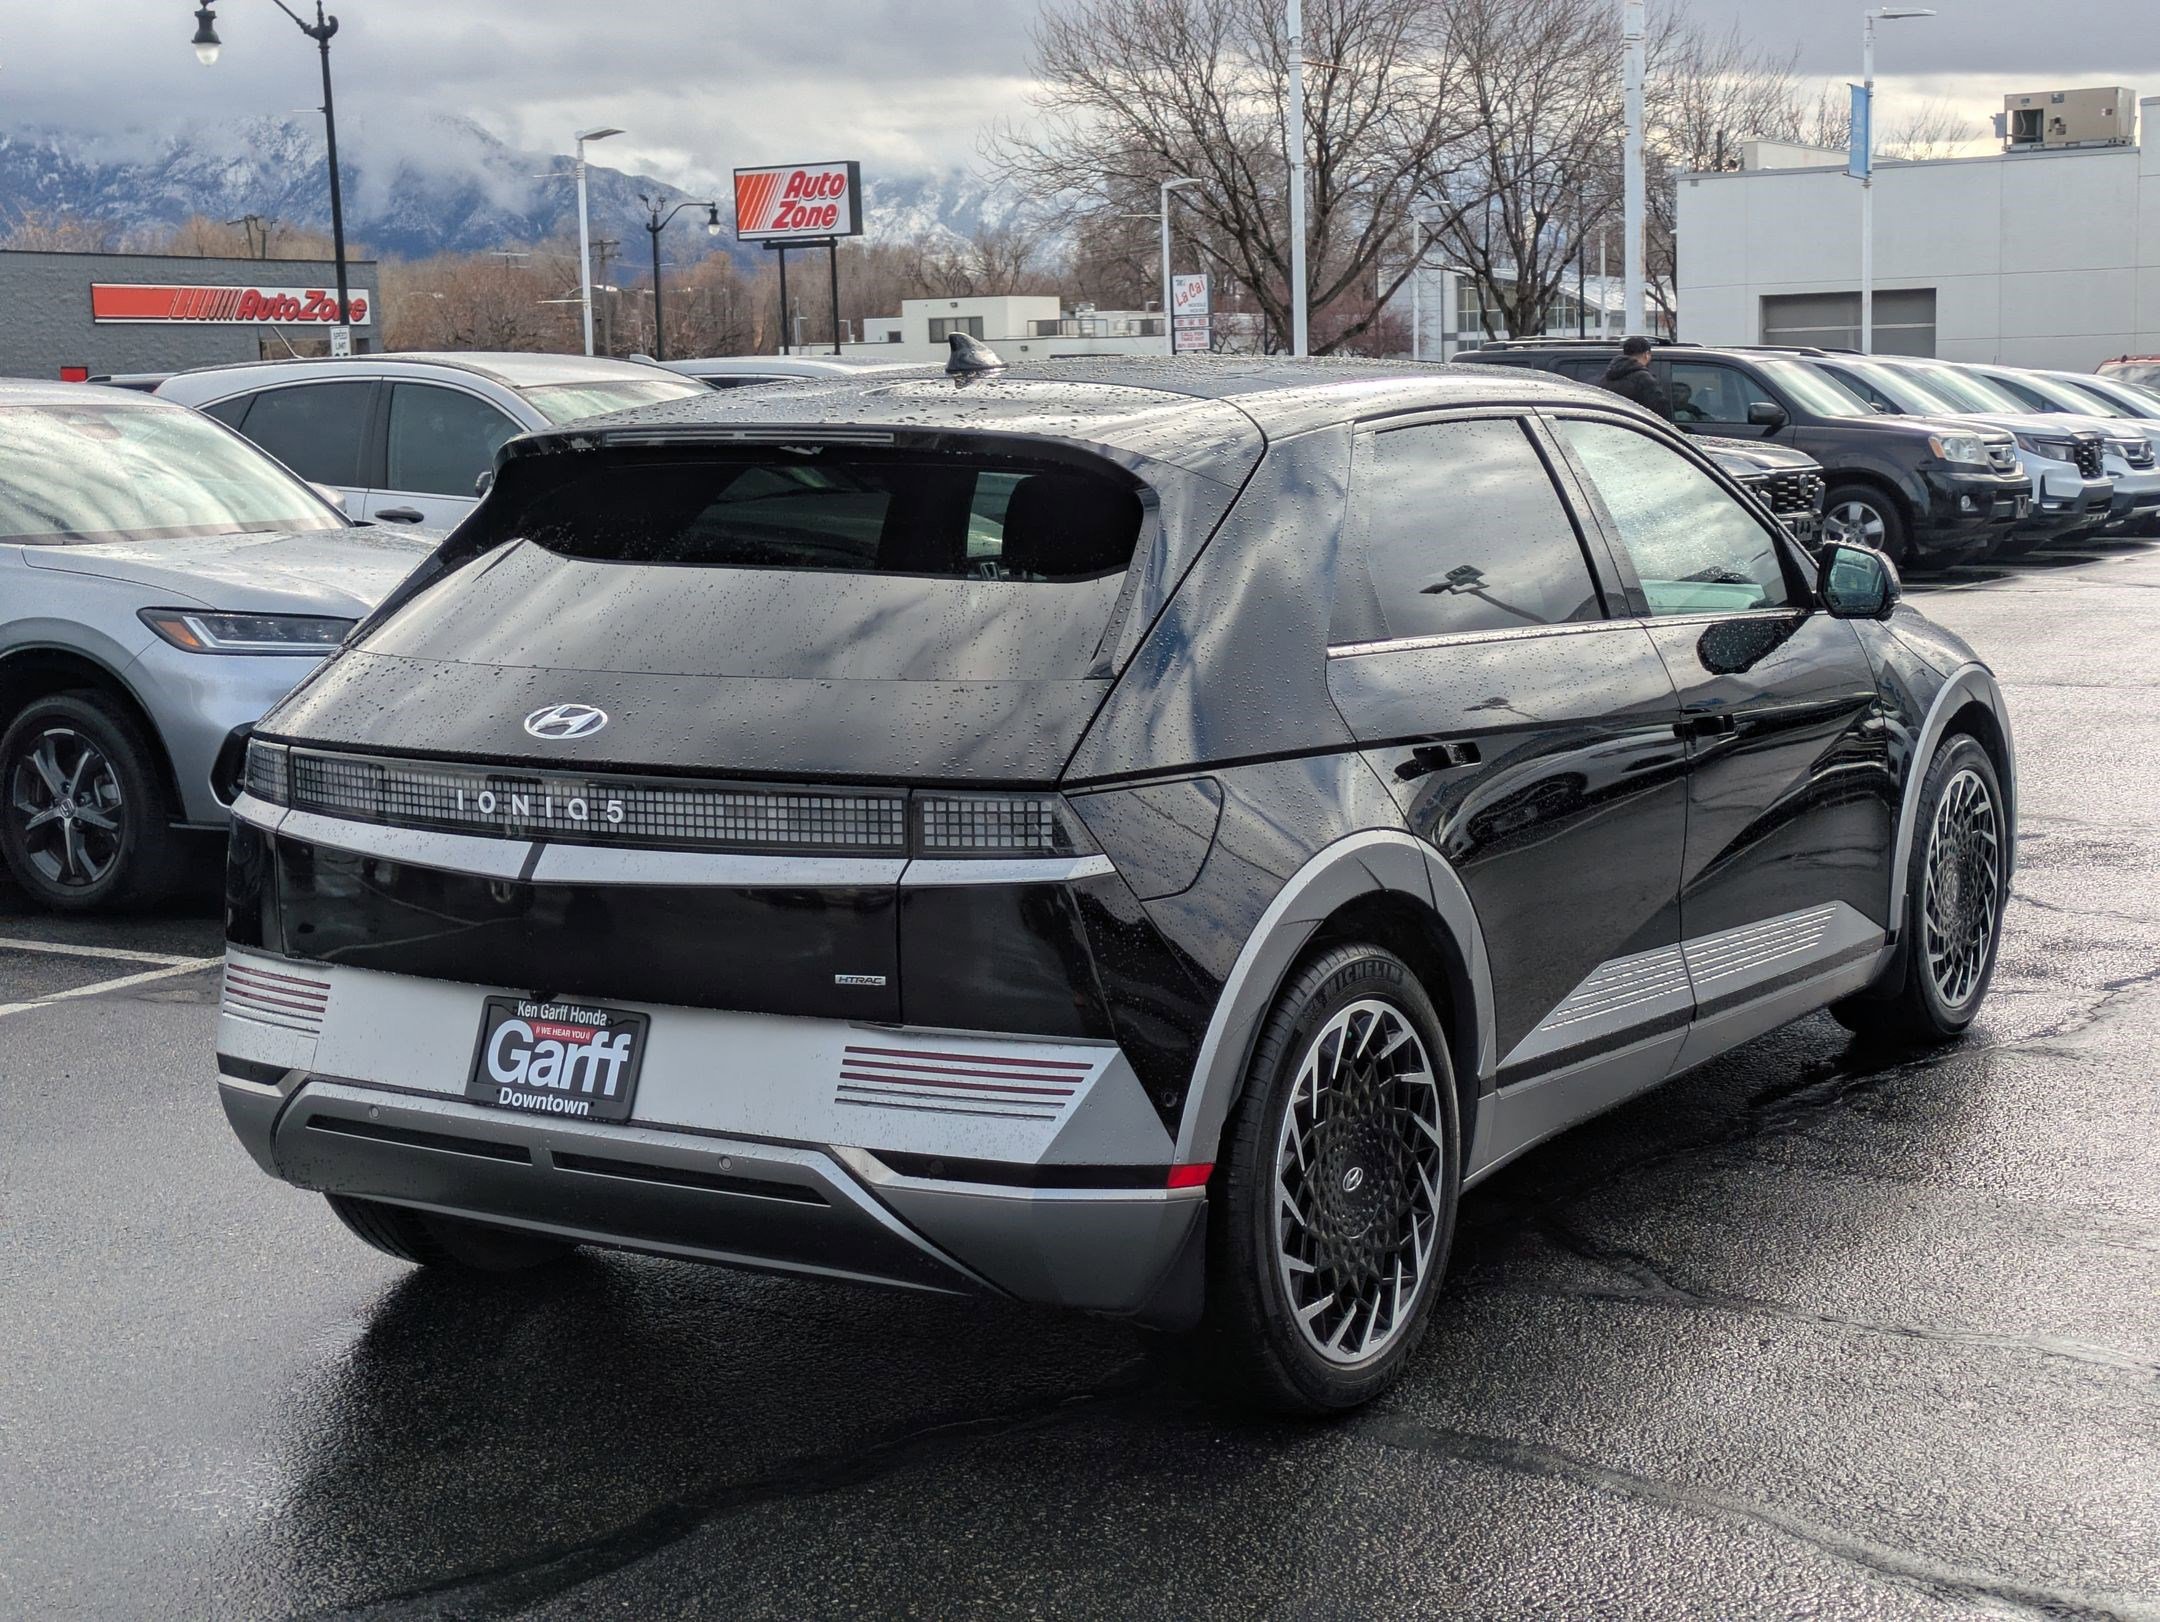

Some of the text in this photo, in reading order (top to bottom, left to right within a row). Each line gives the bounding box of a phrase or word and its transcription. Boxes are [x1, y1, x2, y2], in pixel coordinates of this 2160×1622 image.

[783, 170, 846, 199] Auto
[771, 200, 838, 230] Zone
[1175, 291, 1189, 307] La
[456, 789, 624, 823] IONIQ 5
[838, 976, 884, 984] HTRAC
[1323, 961, 1404, 997] MICHELIN
[517, 1000, 608, 1026] Ken Garff Honda
[541, 1026, 586, 1039] WE HEAR YOU
[487, 1019, 632, 1096] Garff
[499, 1087, 589, 1115] Downtown
